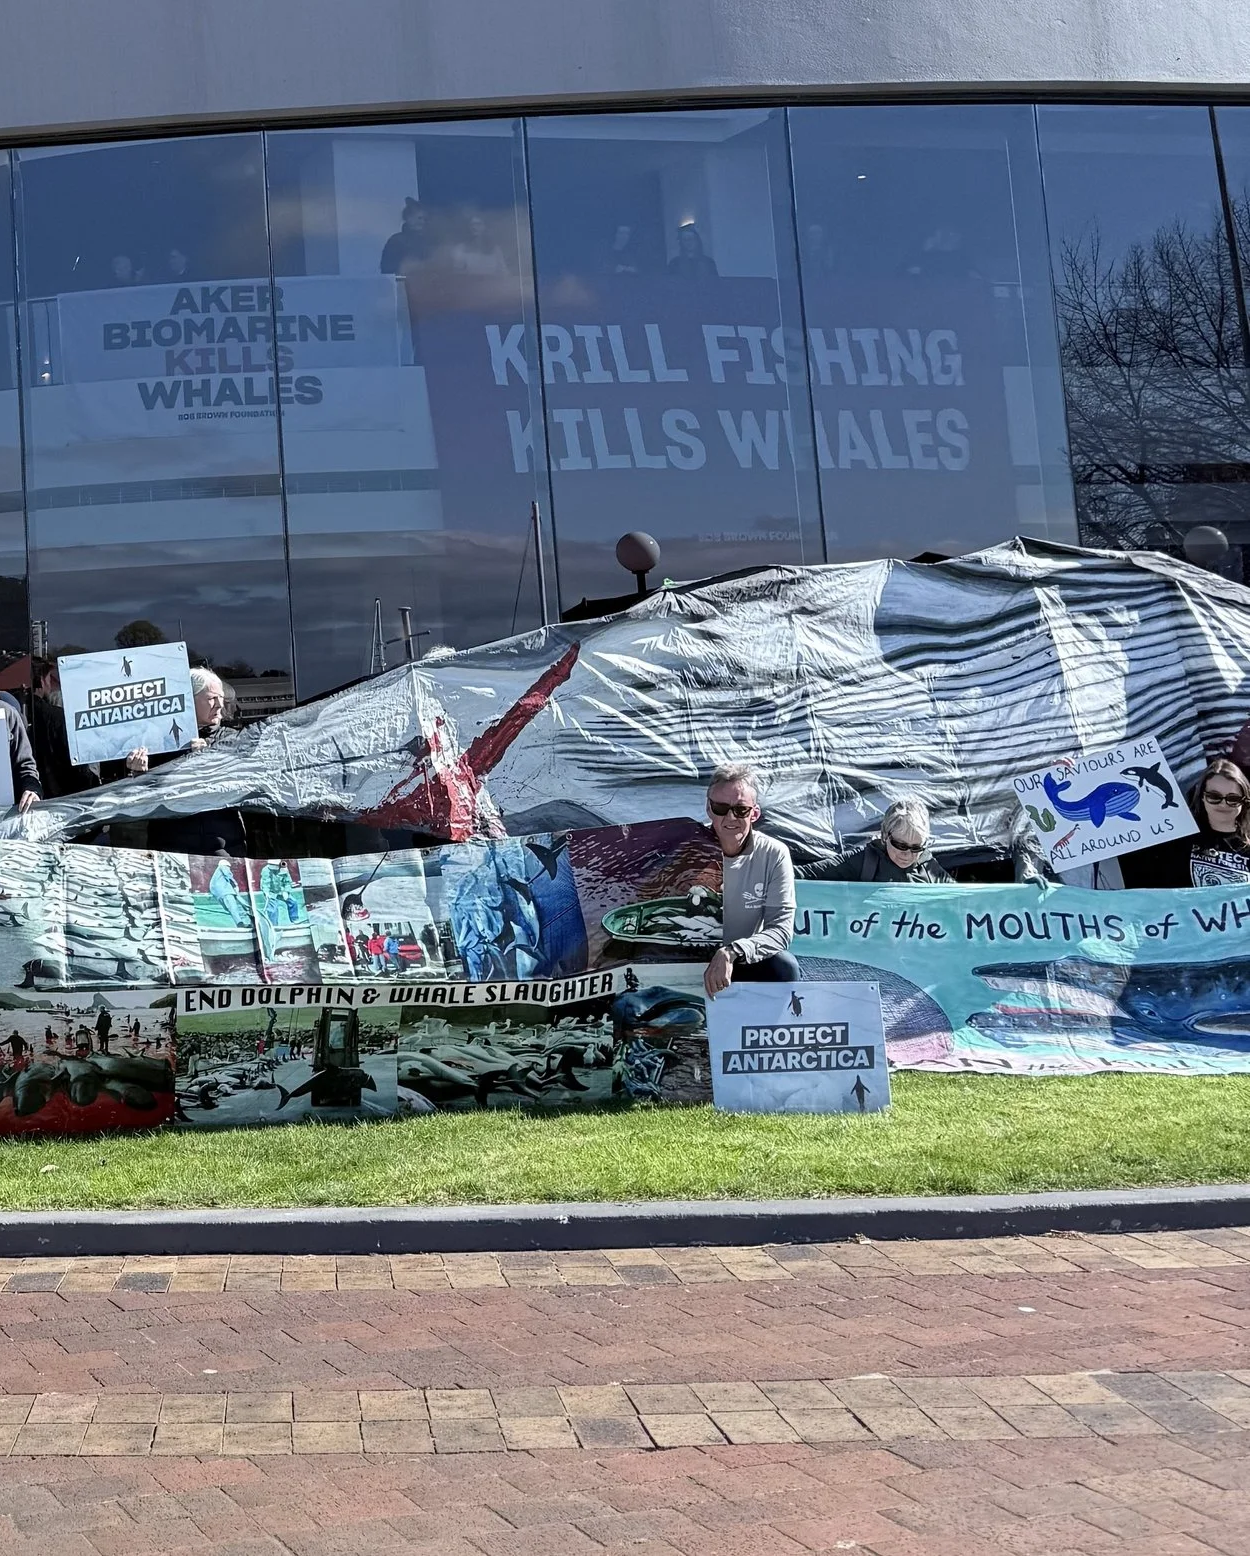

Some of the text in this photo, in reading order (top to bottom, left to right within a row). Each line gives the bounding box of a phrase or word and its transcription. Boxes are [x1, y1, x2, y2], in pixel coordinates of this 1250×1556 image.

[170, 285, 284, 316] AKER
[103, 314, 355, 351] BIOMARINE
[165, 345, 295, 377] KILLS
[485, 324, 967, 387] KRILL FISHING
[137, 375, 324, 411] WHALES
[506, 408, 707, 473] KILLS
[91, 680, 165, 707] PROTECT
[78, 697, 182, 729] ANTARCTICA
[1013, 741, 1157, 793] OUR SAVIOURS ARE
[1050, 818, 1175, 865] ALL AROUND US
[1192, 844, 1249, 866] POTECT
[793, 910, 835, 936] UT
[849, 912, 880, 938] of
[892, 910, 947, 939] the
[966, 911, 1125, 942] MOUTHS
[1145, 913, 1179, 940] of
[184, 973, 613, 1012] END DOLPHIN & WHALE SLAUGHTER
[745, 1026, 846, 1046] PROTECT
[726, 1050, 870, 1072] ANTARCTICA
